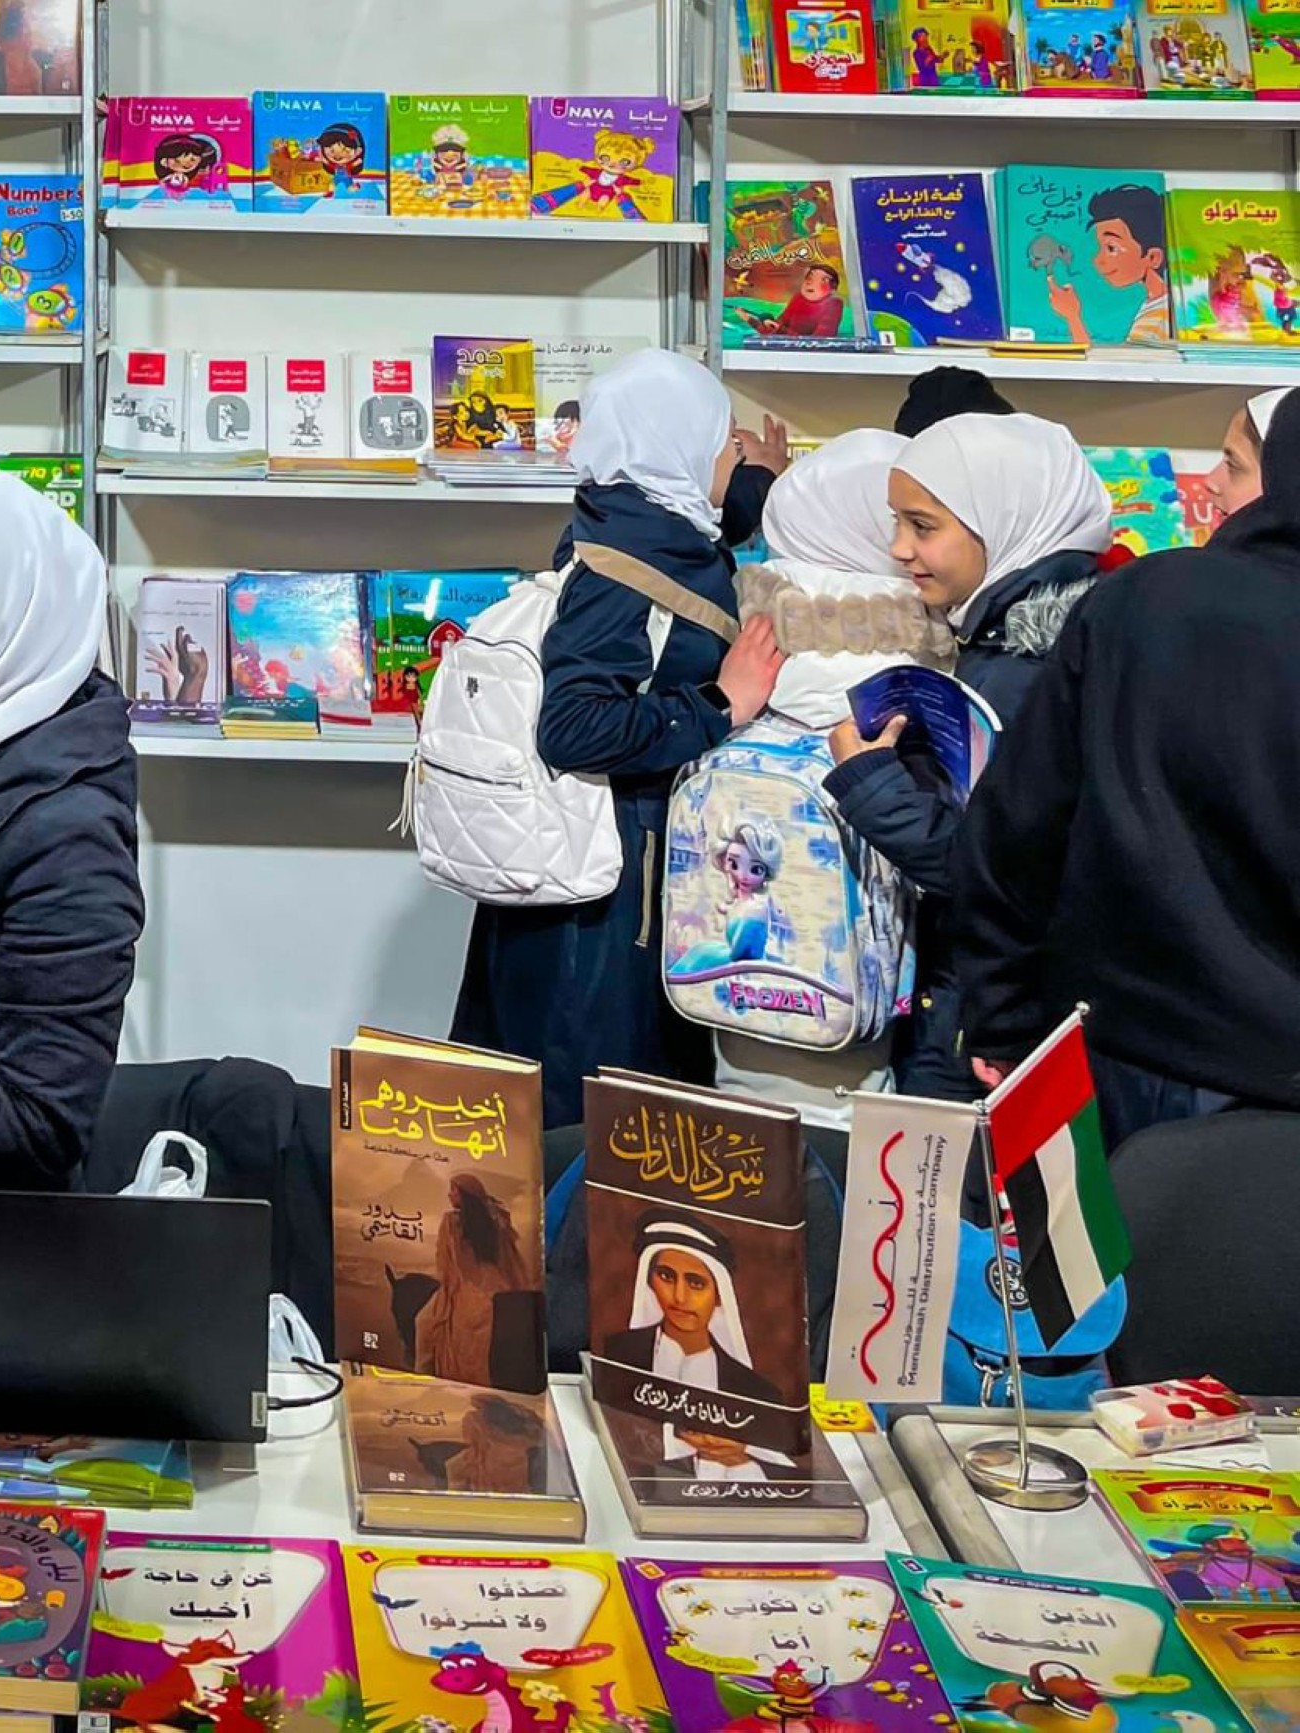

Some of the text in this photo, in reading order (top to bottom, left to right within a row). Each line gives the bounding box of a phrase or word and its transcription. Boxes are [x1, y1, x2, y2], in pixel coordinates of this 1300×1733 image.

[279, 99, 323, 112] NAYA
[417, 101, 463, 113] NAYA
[568, 106, 616, 120] NAYA
[150, 114, 195, 126] NAYA
[1017, 174, 1084, 208] فيل على
[6, 206, 40, 218] Book
[1203, 200, 1279, 224] بيت لولو
[456, 348, 503, 366] حمد
[729, 980, 827, 1021] FROZEN
[358, 1078, 508, 1127] أخبروهم
[358, 1106, 508, 1161] أنها هنا
[914, 1134, 935, 1199] شركة
[926, 1135, 948, 1210] Company
[360, 1202, 423, 1221] بدور
[360, 1219, 425, 1244] القاسمي
[917, 1211, 937, 1304] Distribution
[699, 1400, 755, 1429] سلطان
[143, 1566, 200, 1584] حاجة
[210, 1568, 234, 1591] في
[168, 1596, 252, 1623] أخيك
[515, 1612, 548, 1633] ولا
